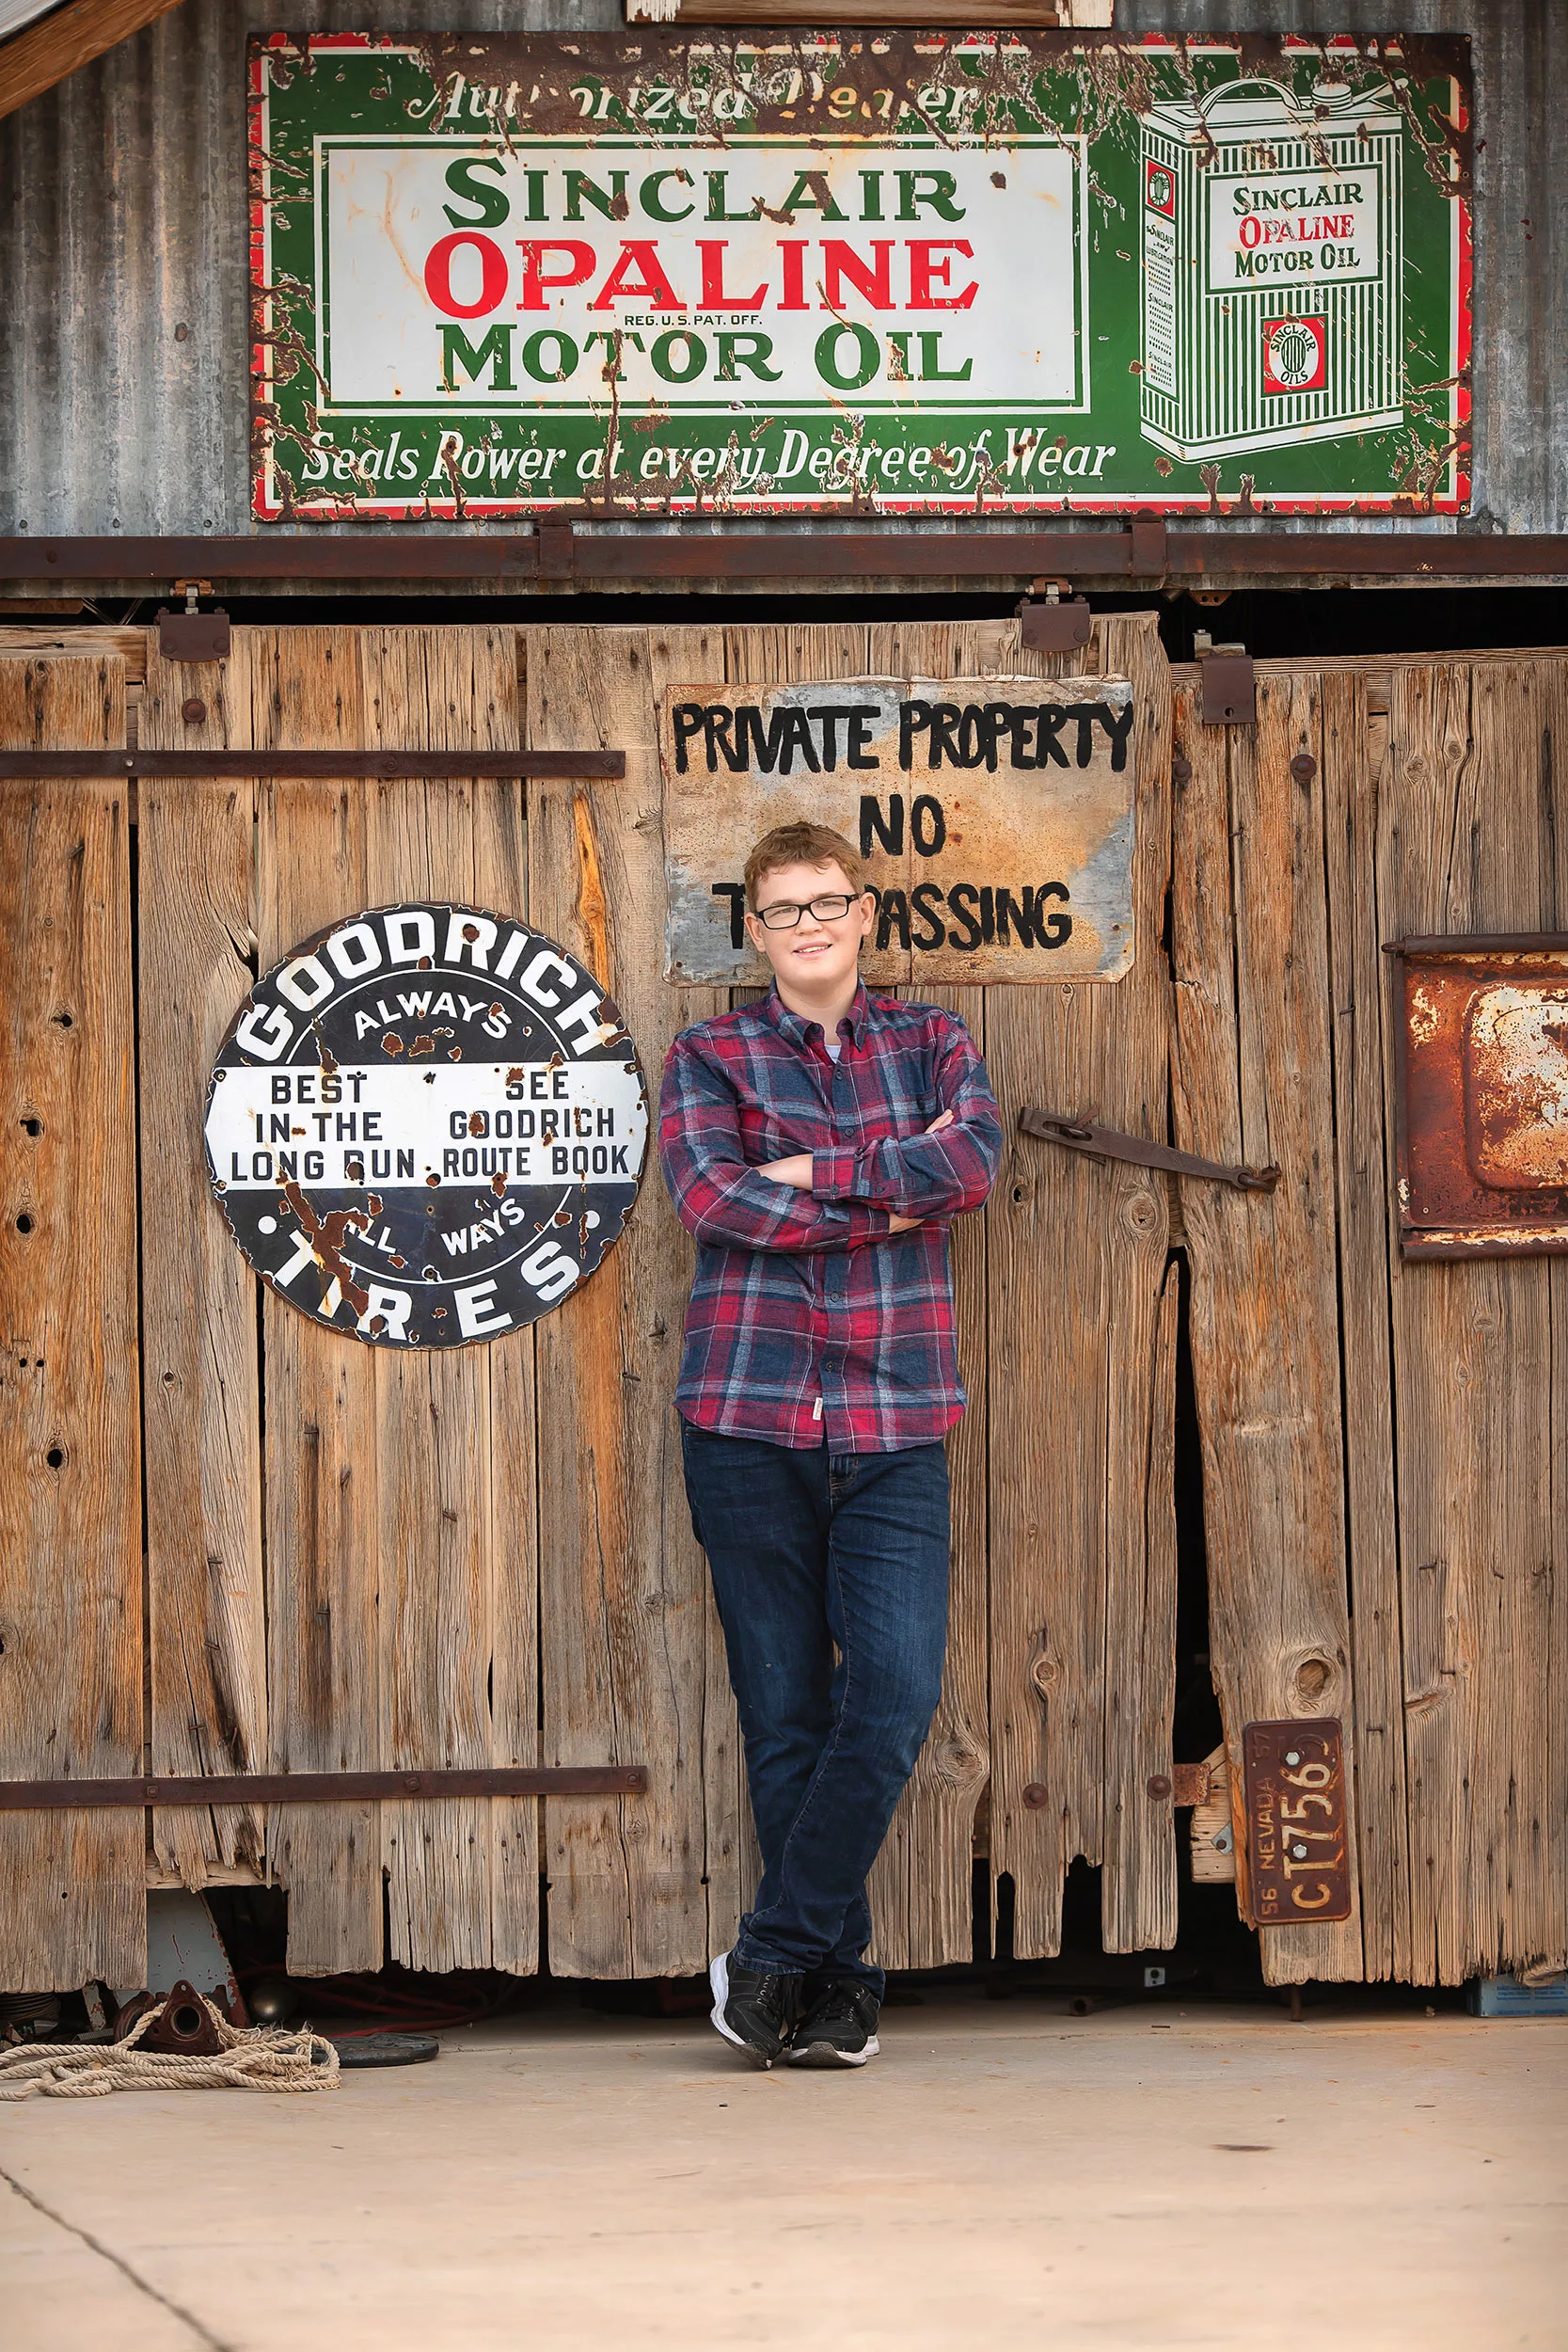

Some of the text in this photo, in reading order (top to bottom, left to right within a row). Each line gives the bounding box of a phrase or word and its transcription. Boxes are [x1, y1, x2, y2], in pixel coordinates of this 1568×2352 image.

[442, 156, 966, 229] SINCLAIR
[1233, 183, 1364, 215] SINCLAIR
[1239, 215, 1354, 249] OPALINE
[424, 231, 980, 319] OPALINE
[1235, 243, 1361, 278] MOTOR OIL
[625, 315, 658, 326] REG.
[731, 315, 763, 326] OFF.
[1270, 325, 1317, 353] SINCLAIR
[436, 323, 974, 391] MOTOR OIL
[1280, 370, 1308, 385] OILS
[301, 427, 1117, 490] Seals Power at every Degree of Wear
[673, 699, 1134, 775] PRIVATE PROPERTY
[859, 794, 947, 859] NO
[712, 881, 1072, 951] TASSING
[236, 911, 619, 1062] GOODRICH
[354, 991, 512, 1040] ALWAYS
[271, 1074, 368, 1104] BEST
[505, 1071, 570, 1101] SEE
[255, 1111, 382, 1143] IN THE
[450, 1108, 615, 1139] GOODRICH
[231, 1151, 325, 1182] LONG
[443, 1145, 629, 1178] ROUTE BOOK
[440, 1198, 526, 1257] WAYS
[273, 1229, 581, 1343] TIRES
[1256, 1776, 1275, 1870] NEVADA
[1261, 1887, 1278, 1915] 56
